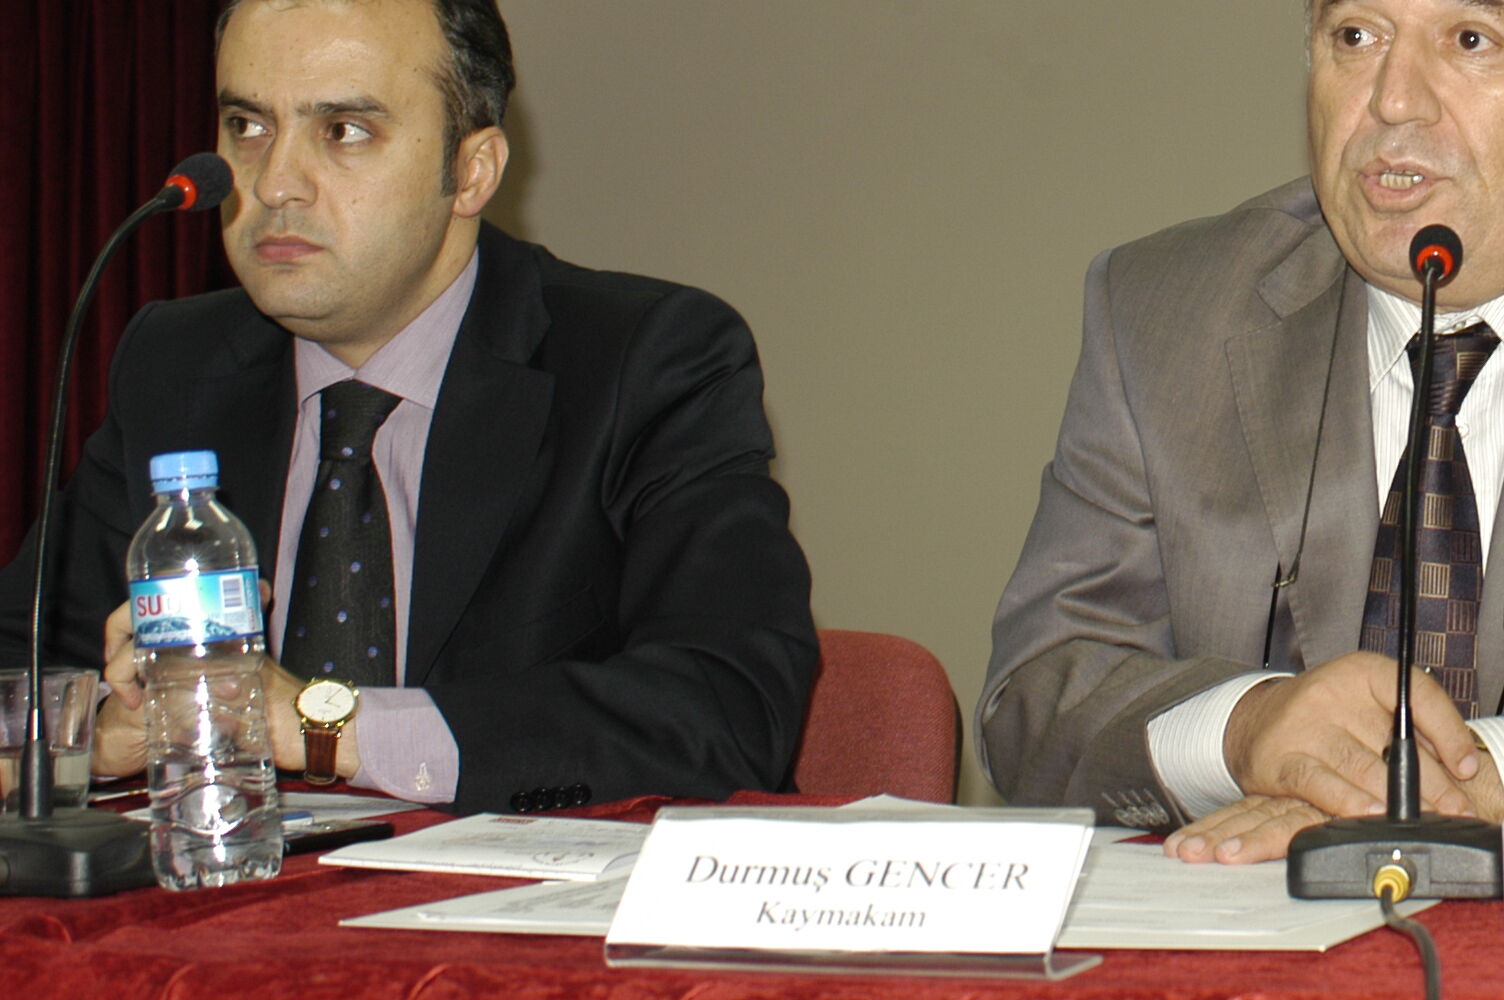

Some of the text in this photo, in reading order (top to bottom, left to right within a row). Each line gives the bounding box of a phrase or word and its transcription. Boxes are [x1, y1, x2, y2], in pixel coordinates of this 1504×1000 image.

[685, 855, 1030, 894] Durmuş GENCER
[756, 901, 927, 932] Kaymakam
